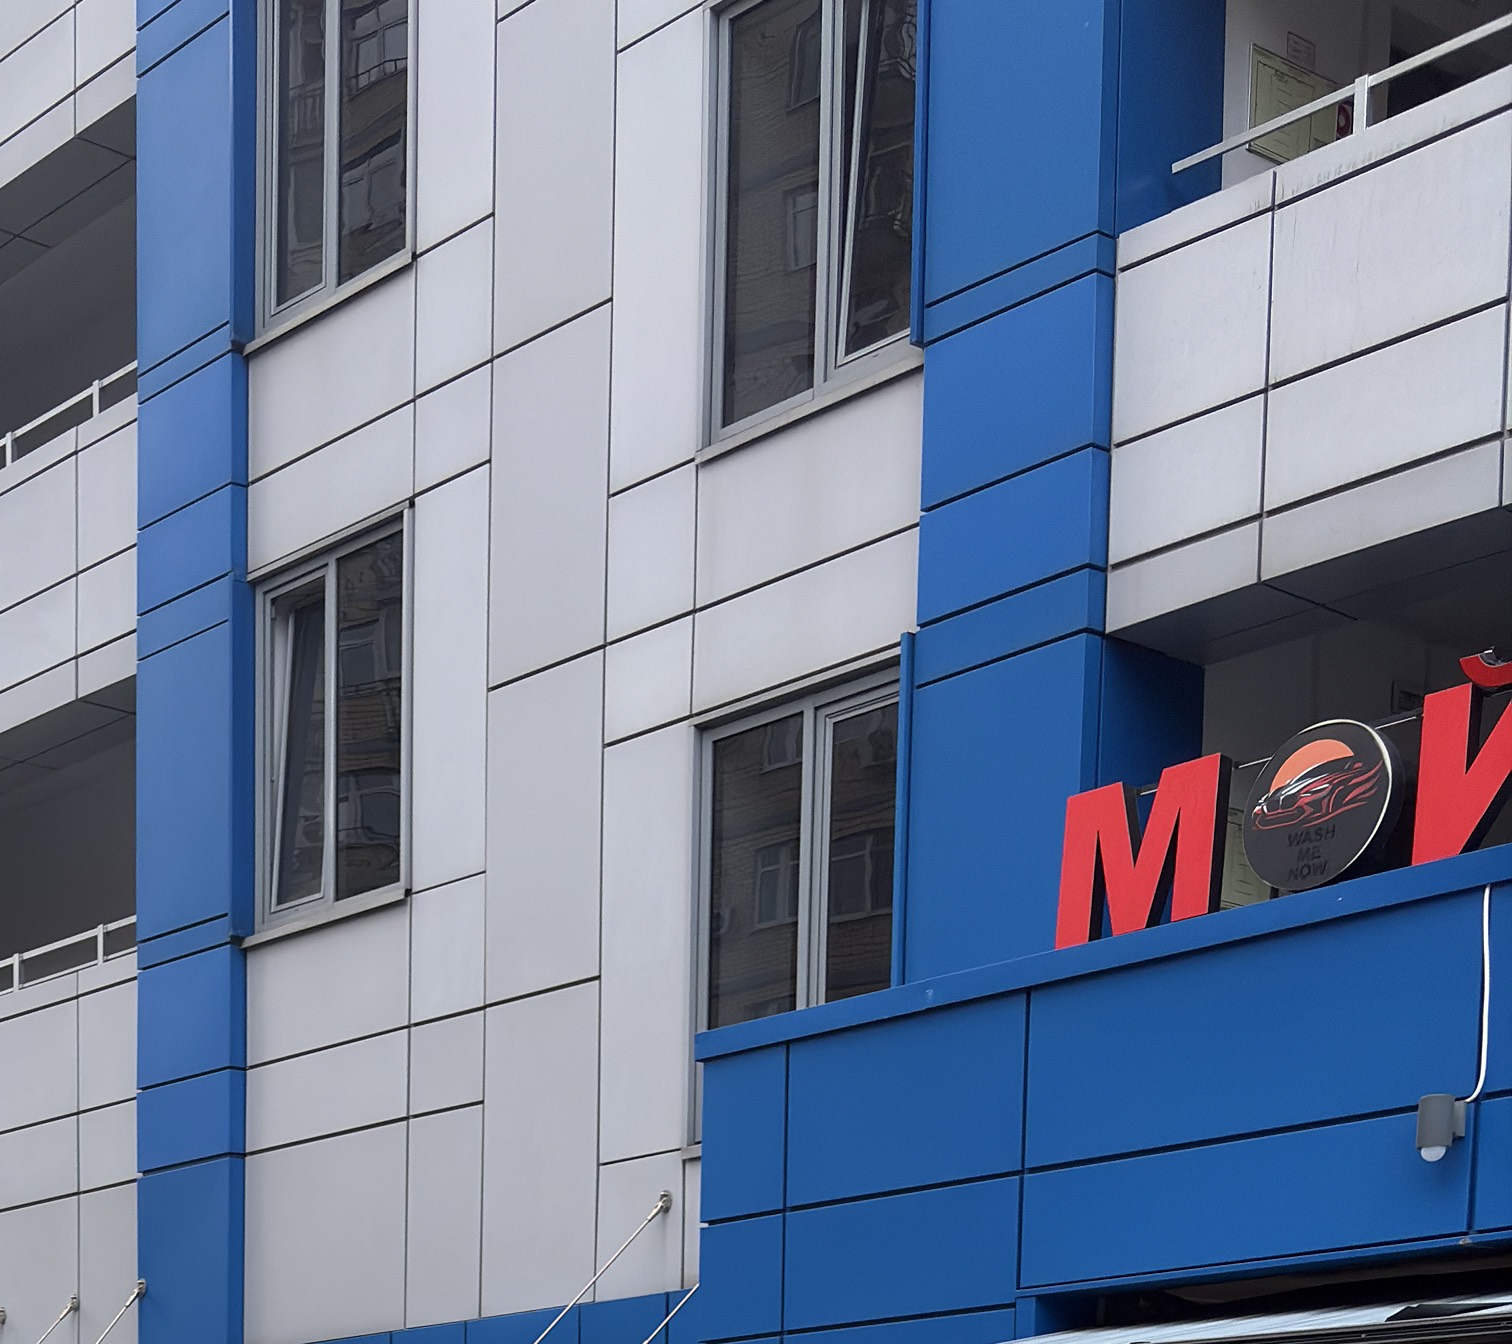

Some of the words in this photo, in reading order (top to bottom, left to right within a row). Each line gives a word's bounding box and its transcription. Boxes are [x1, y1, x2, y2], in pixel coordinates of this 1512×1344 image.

[1288, 825, 1336, 848] WASH
[1297, 848, 1321, 863] ME
[1288, 860, 1328, 882] NOW
